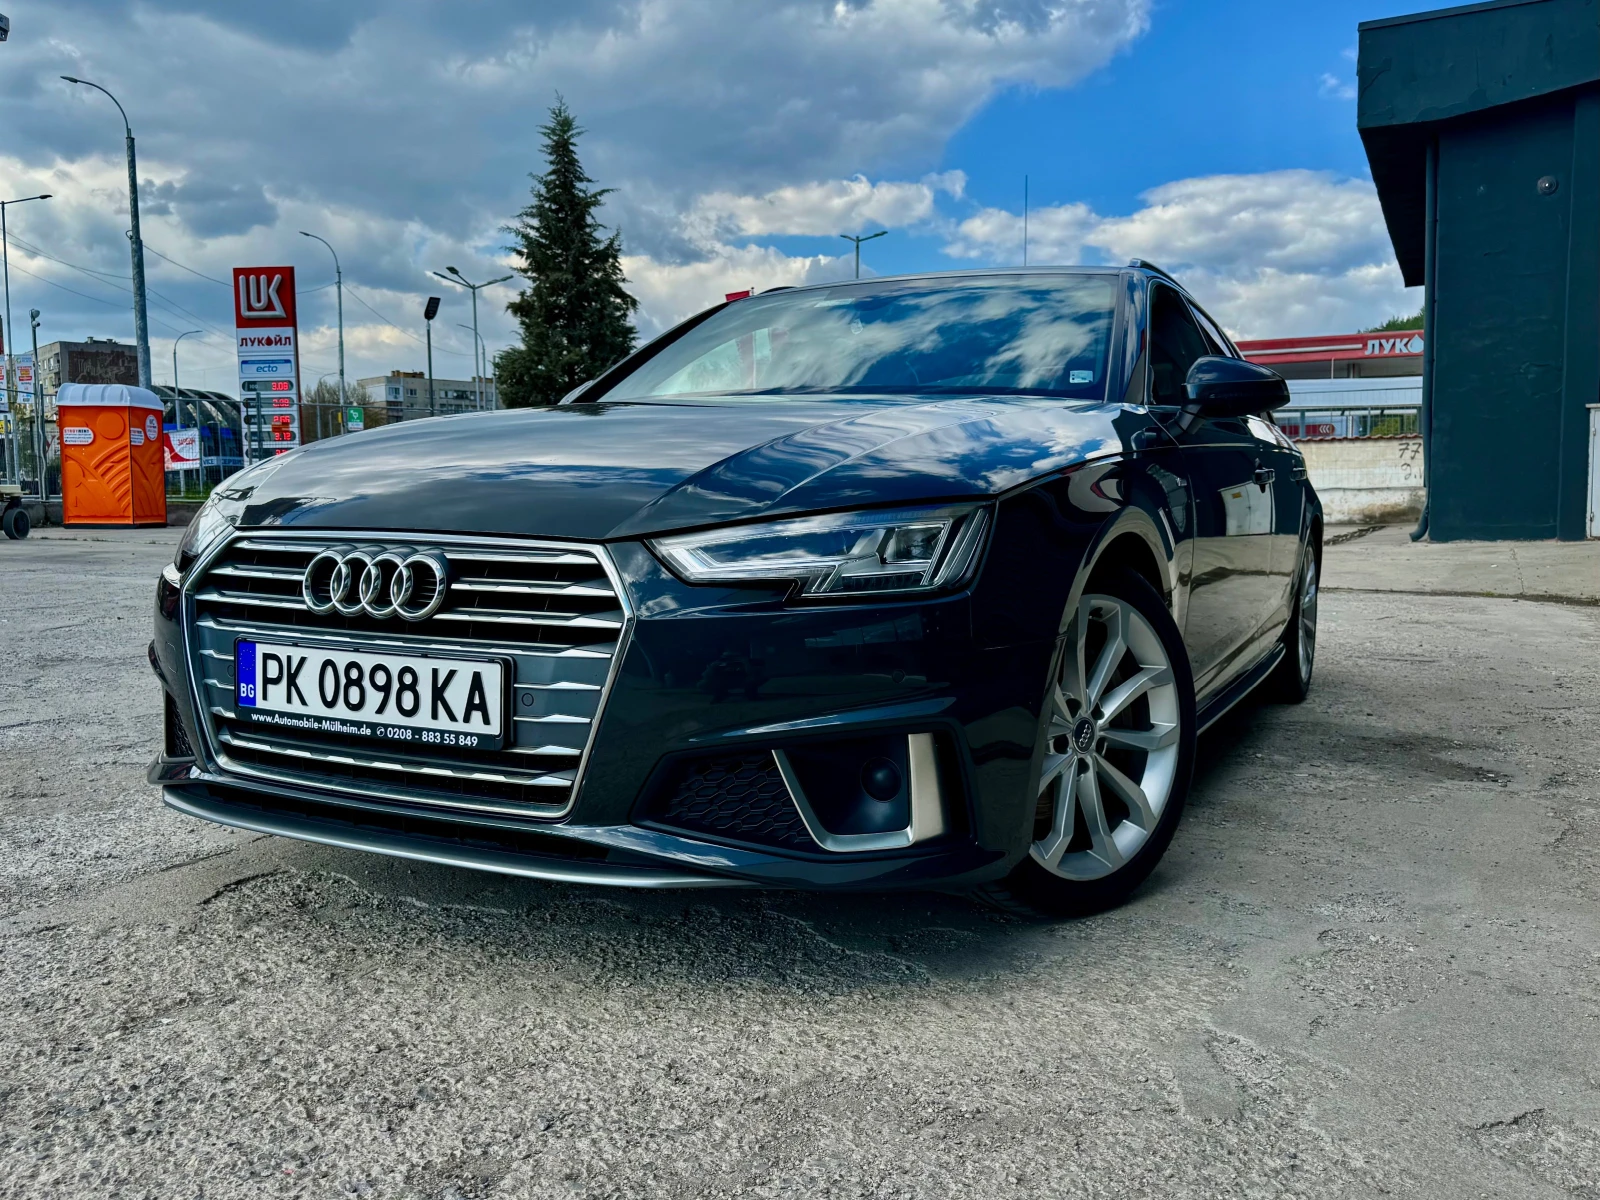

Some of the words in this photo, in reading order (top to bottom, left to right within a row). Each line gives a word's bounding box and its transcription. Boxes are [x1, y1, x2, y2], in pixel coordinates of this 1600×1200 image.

[256, 364, 278, 373] ecto
[240, 683, 255, 698] BG
[262, 652, 309, 707] PK
[318, 658, 421, 718] 0898
[431, 667, 491, 726] KA
[251, 713, 372, 736] www.Automobile-Mülheim.de
[387, 727, 412, 740] 0208
[422, 731, 441, 743] 883
[443, 733, 456, 745] 55
[458, 736, 478, 747] 849
